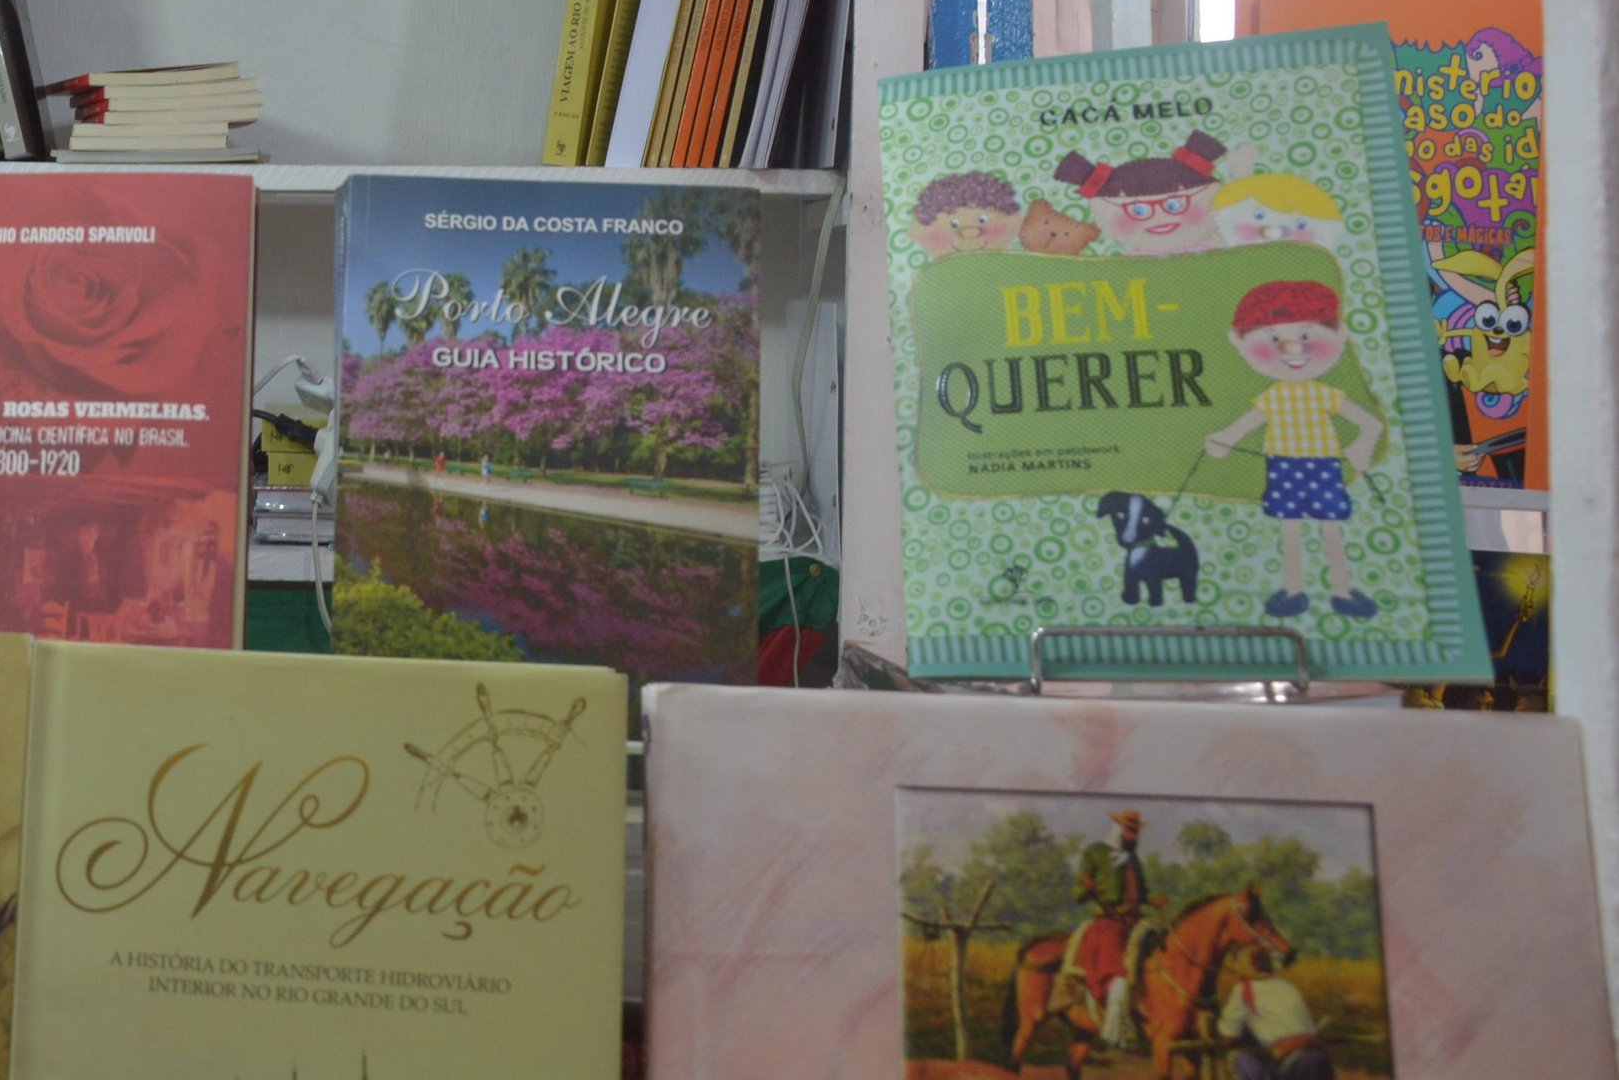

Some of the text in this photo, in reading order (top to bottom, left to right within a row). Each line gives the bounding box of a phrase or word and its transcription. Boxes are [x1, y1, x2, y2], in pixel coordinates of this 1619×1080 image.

[571, 2, 584, 27] RIO
[568, 29, 580, 48] AO
[559, 50, 576, 103] VIAGEM
[1039, 97, 1213, 126] CACÁ MELO
[1484, 105, 1521, 129] do
[1444, 134, 1494, 163] das
[20, 226, 84, 243] CARDOSO
[88, 226, 156, 243] SPARVOLI
[424, 212, 683, 236] SÉRGIO DA COSTA FRANCO
[392, 266, 713, 349] Porto Alegre
[1000, 278, 1180, 350] BEM-
[432, 343, 667, 375] GUIA HISTÓRICO
[935, 347, 1214, 433] QUERER
[2, 400, 70, 418] ROSAS
[74, 402, 210, 420] VERMELHAS.
[37, 425, 108, 446] CIENTÍFICA
[114, 428, 134, 446] NO
[968, 459, 1092, 474] NADIA MARTINS
[56, 743, 580, 948] Navegação
[110, 950, 512, 995] A HISTÓRIA DO TRANSPORTE HIDROVIÁRIO
[148, 976, 467, 1016] INTERIOR NO RIO GRANDE DO SUL
